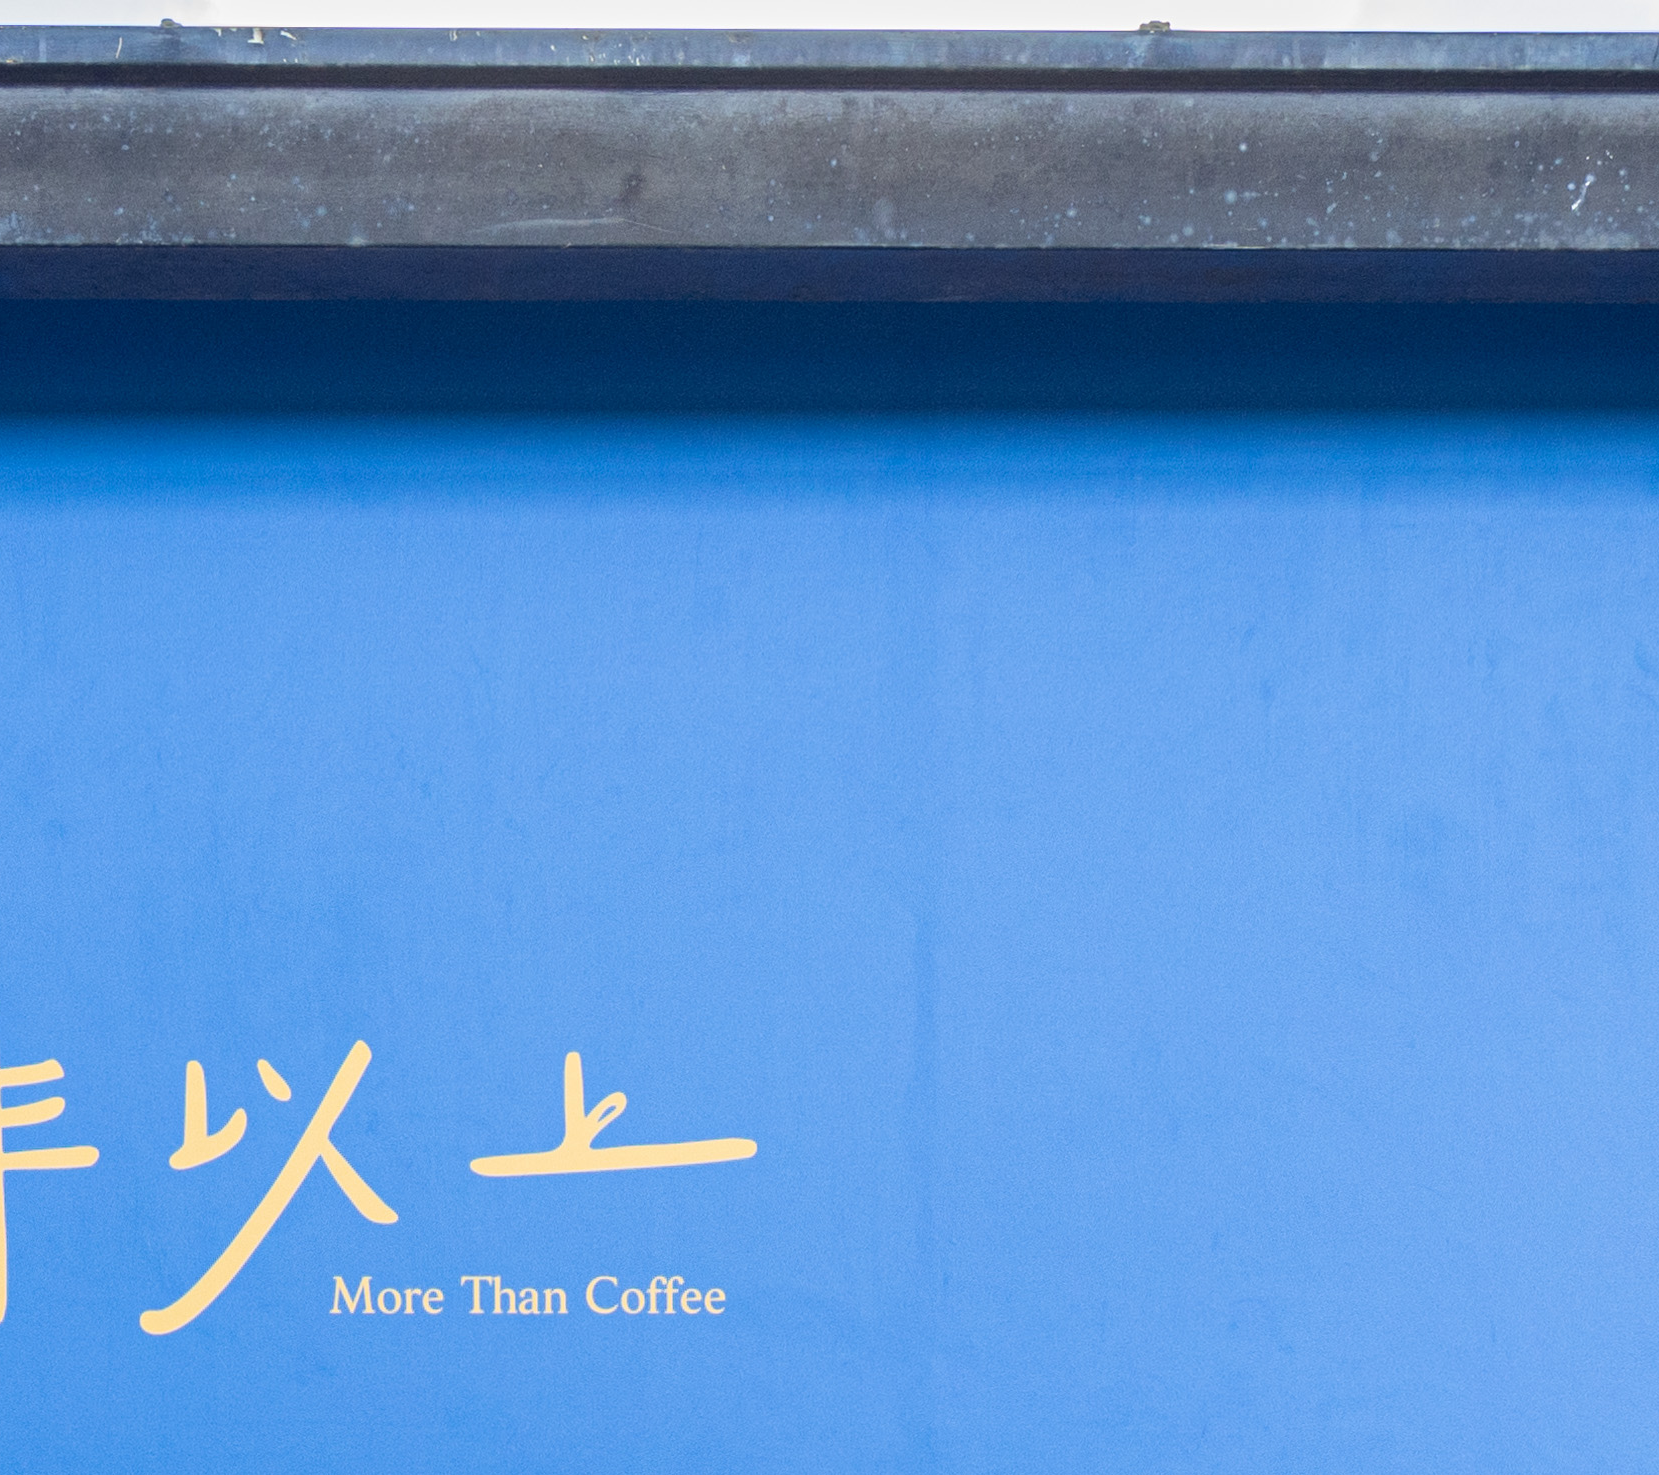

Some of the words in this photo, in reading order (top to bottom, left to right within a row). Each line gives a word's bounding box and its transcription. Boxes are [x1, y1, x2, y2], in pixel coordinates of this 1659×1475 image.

[330, 1276, 445, 1315] More
[460, 1276, 568, 1315] Than
[585, 1276, 726, 1315] Coffee
